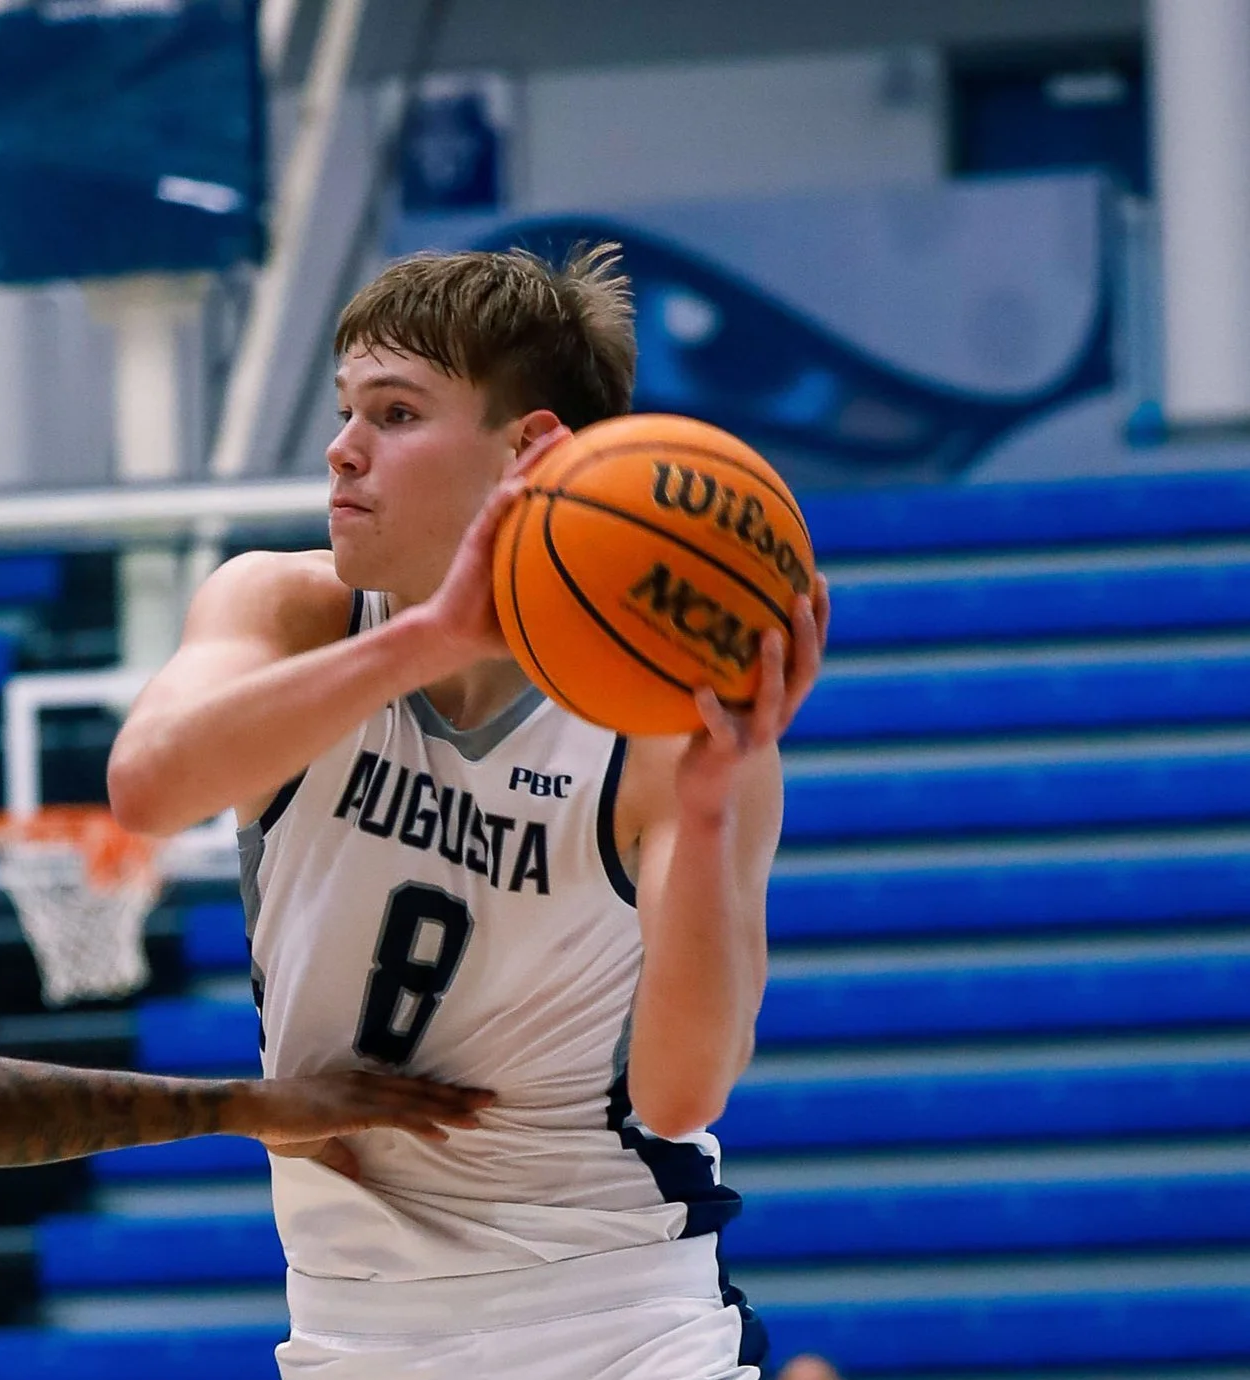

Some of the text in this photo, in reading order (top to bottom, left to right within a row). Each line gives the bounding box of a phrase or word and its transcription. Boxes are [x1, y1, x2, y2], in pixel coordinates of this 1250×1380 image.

[653, 461, 810, 595] Wilson
[334, 751, 550, 895] AUGUSTA
[509, 767, 572, 799] PBC
[352, 880, 475, 1066] 8
